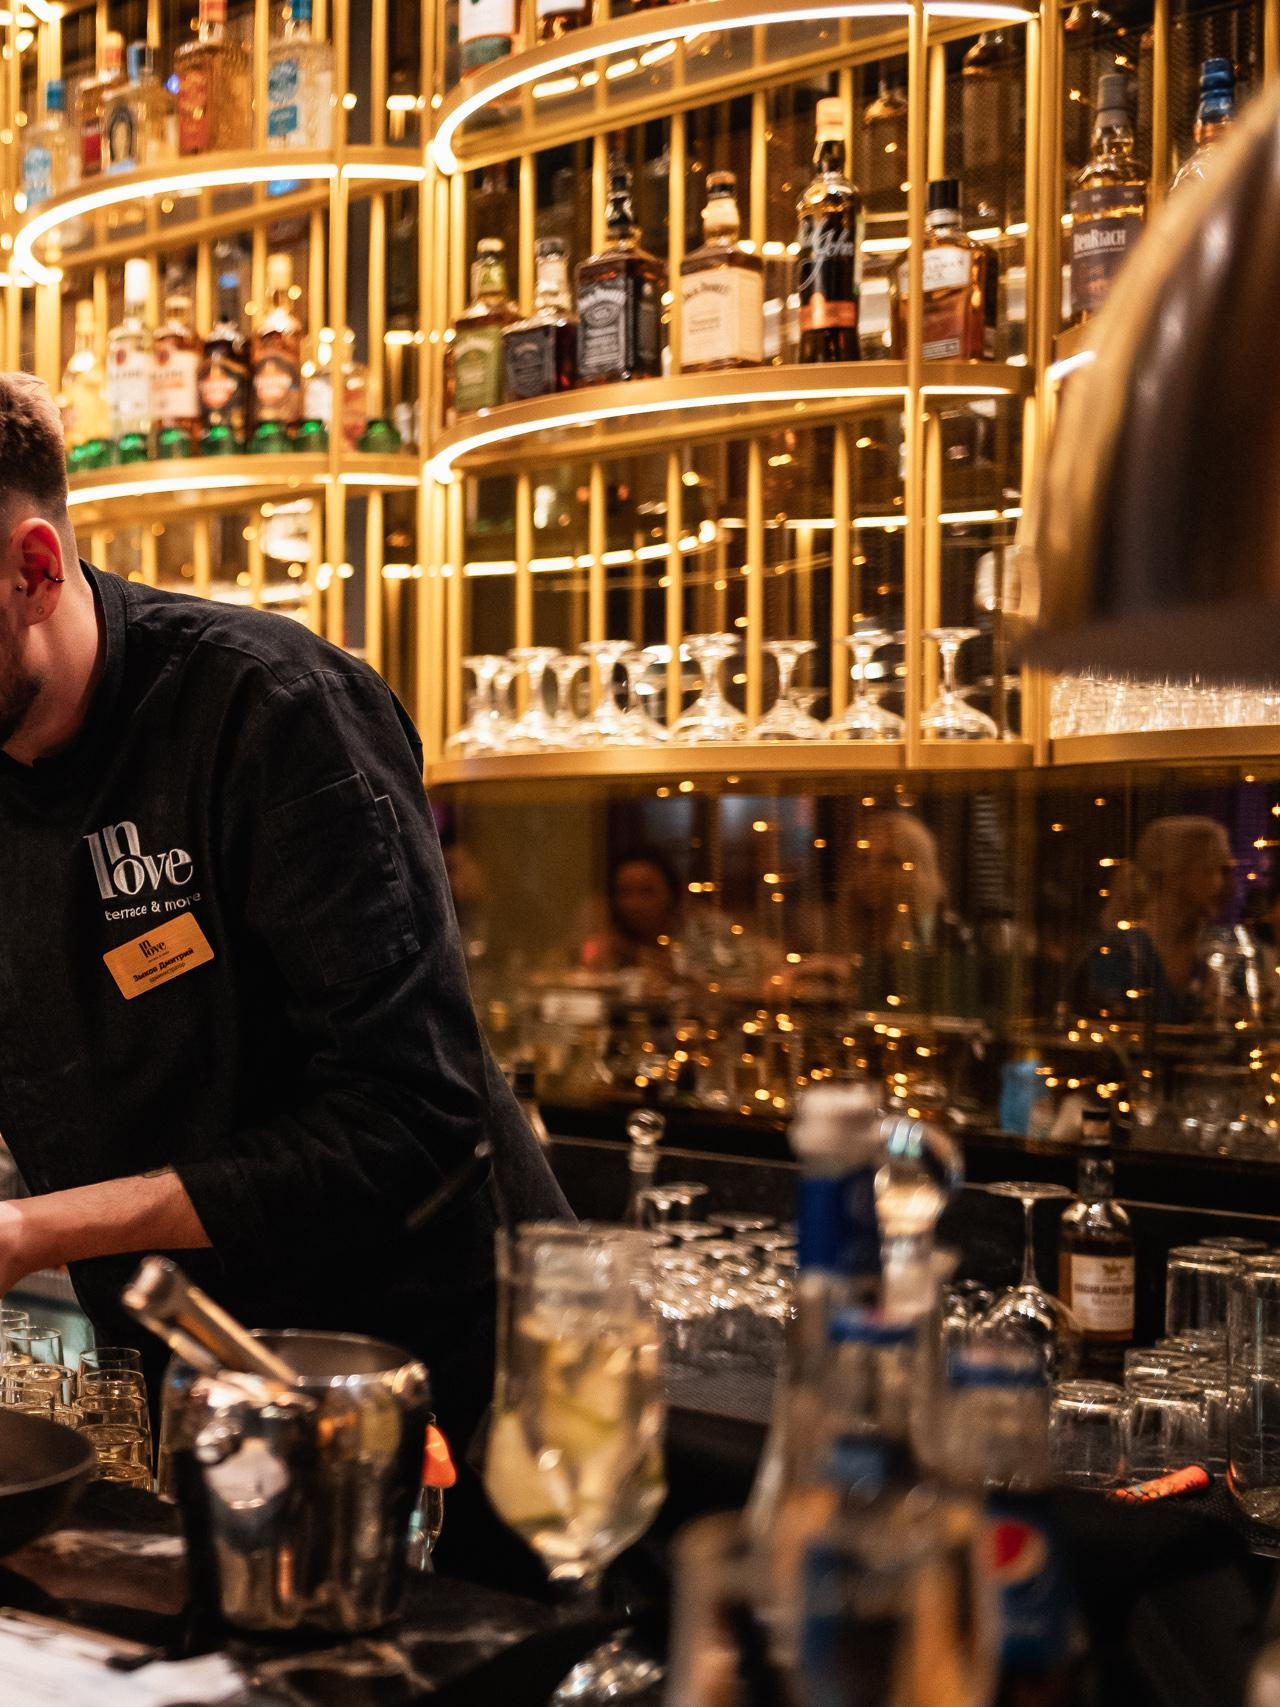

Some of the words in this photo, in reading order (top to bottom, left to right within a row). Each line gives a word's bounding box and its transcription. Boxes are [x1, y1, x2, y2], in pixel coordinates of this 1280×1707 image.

[104, 904, 148, 922] terrace
[150, 900, 161, 914] &
[164, 892, 202, 913] more
[158, 947, 195, 970] Дмитрий
